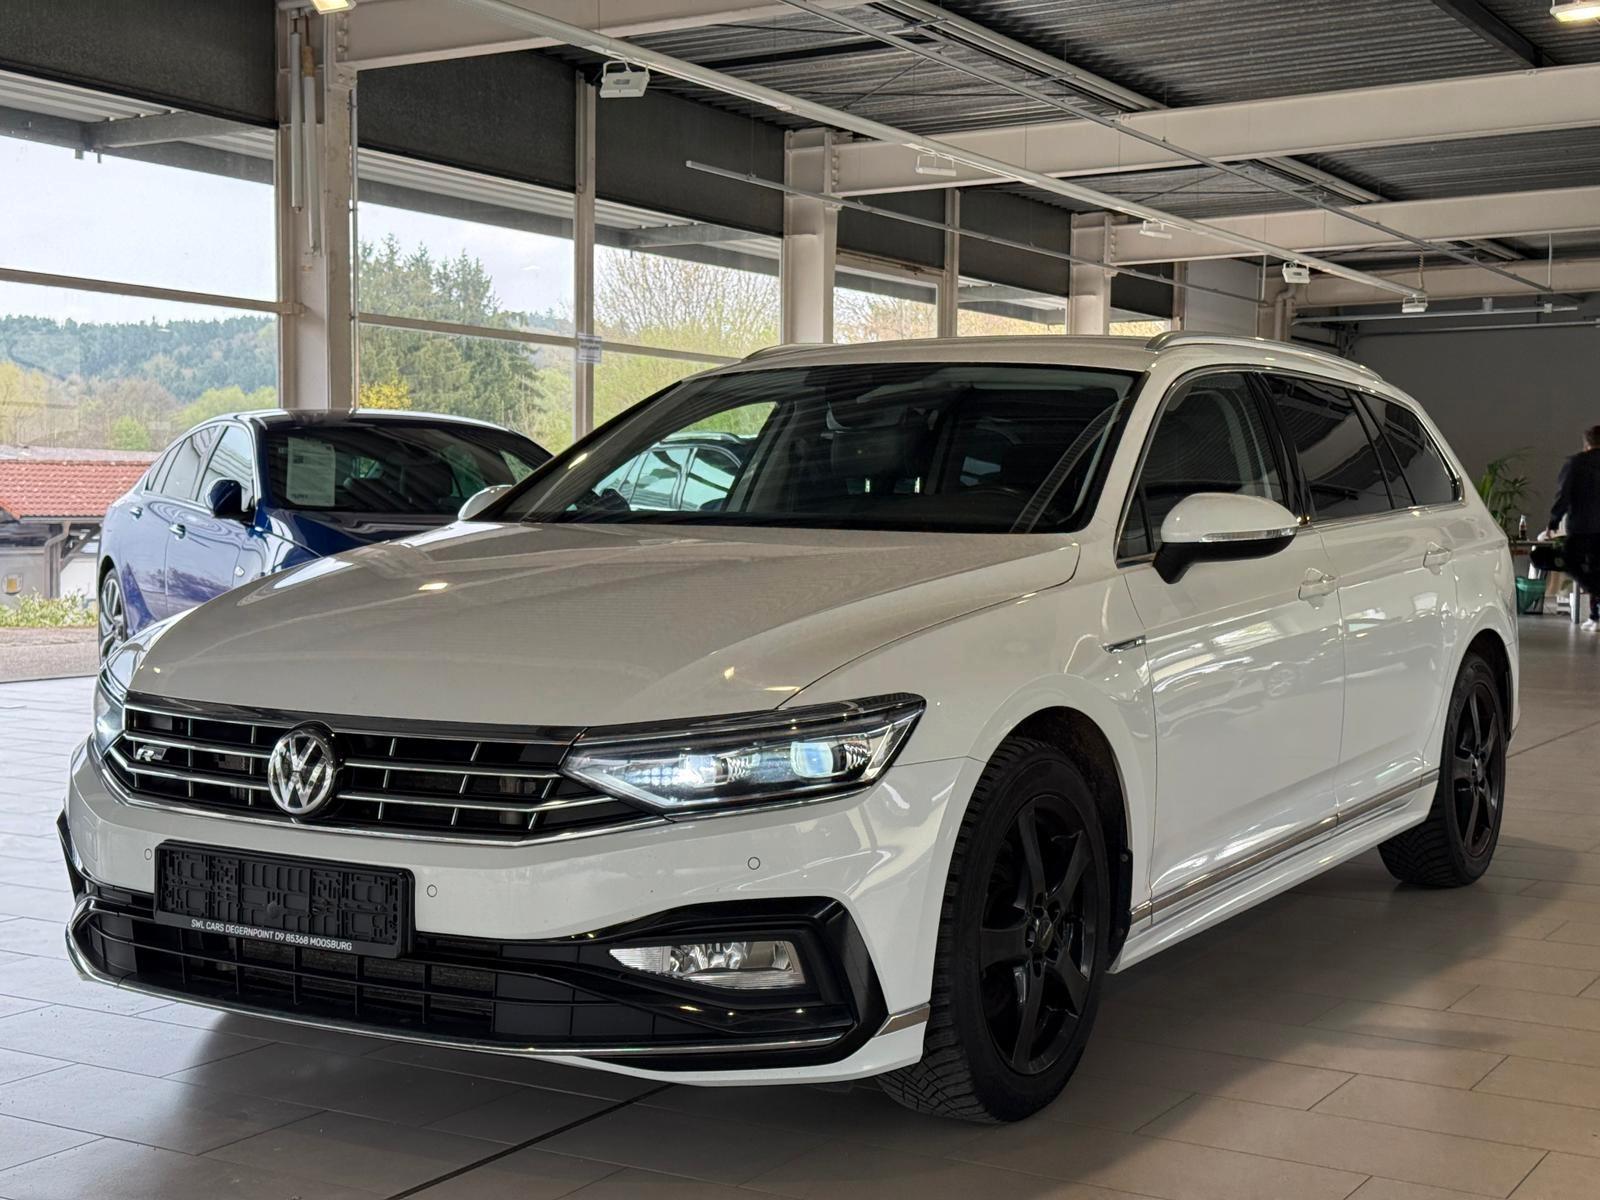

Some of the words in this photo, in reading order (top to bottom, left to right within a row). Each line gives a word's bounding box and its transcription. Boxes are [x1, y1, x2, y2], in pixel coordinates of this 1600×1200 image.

[191, 918, 205, 929] SWL
[206, 921, 225, 932] CARS
[225, 924, 274, 940] DEGERNPOINT
[274, 931, 285, 941] D9
[285, 933, 309, 945] 85368
[310, 936, 352, 951] MOOSBURG
